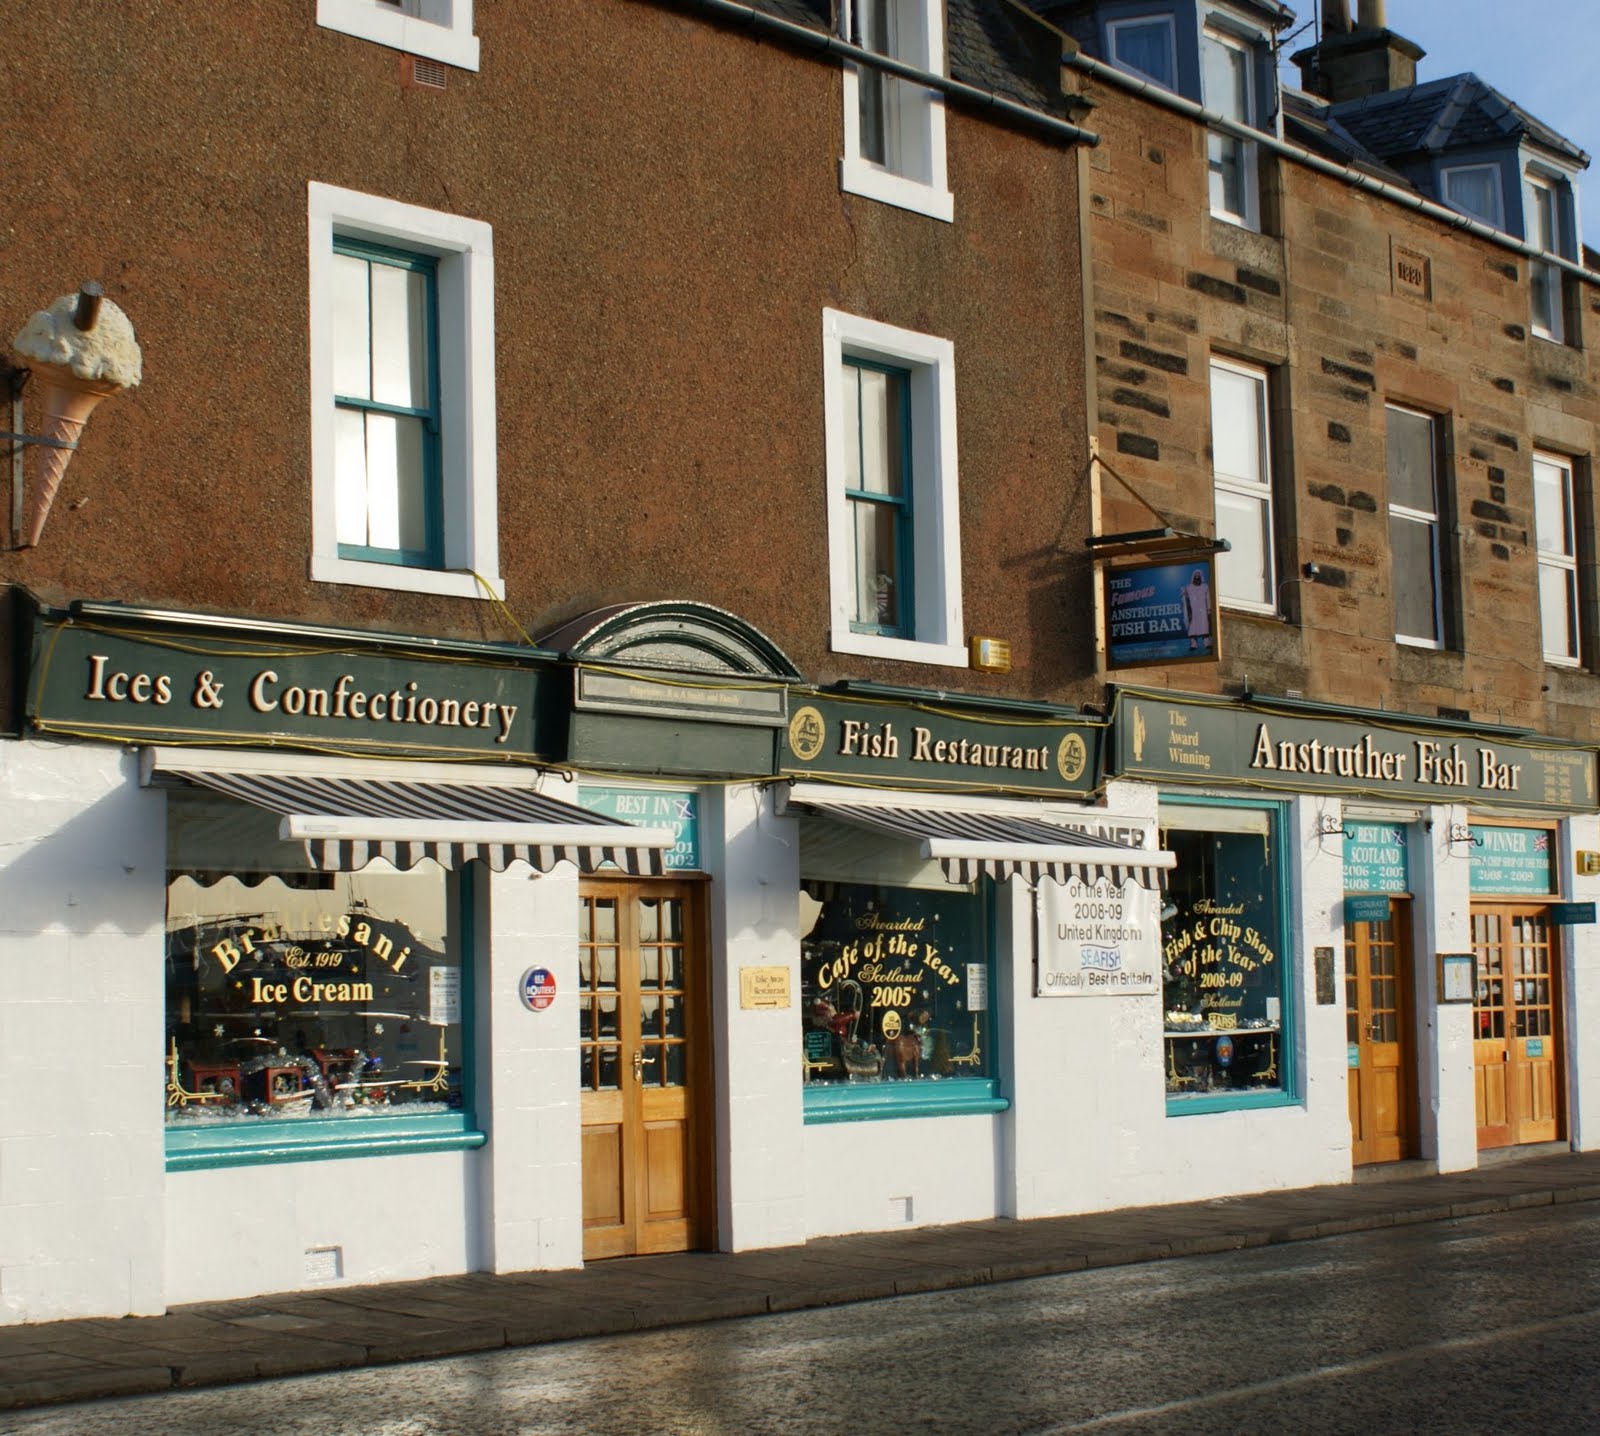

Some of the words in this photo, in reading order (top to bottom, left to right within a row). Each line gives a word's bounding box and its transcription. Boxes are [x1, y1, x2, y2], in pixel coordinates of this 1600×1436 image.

[1110, 578, 1132, 589] THE
[1111, 603, 1182, 621] ANSTRUTHER
[1111, 621, 1146, 637] FISH
[1148, 618, 1182, 633] BAR
[86, 655, 172, 704] Ices
[195, 670, 225, 709] &
[251, 669, 518, 743] Confectionery
[1167, 710, 1187, 726] The
[840, 720, 899, 758] Fish
[912, 727, 1049, 770] Restaurant
[1168, 730, 1199, 746] Award
[1168, 747, 1211, 770] Winning
[1249, 723, 1406, 781] Anstruther
[1415, 740, 1469, 786] Fish
[1479, 748, 1521, 791] Bar
[615, 795, 649, 814] BEST
[653, 797, 671, 815] IN
[1357, 827, 1378, 843] BEST
[1483, 831, 1526, 852] WINNER
[1351, 847, 1400, 864] SCOTLAND
[1379, 867, 1405, 878] 2007
[1510, 871, 1534, 881] 2009
[1070, 883, 1082, 898] of
[1085, 884, 1102, 898] the
[1104, 883, 1126, 899] Year
[1074, 903, 1123, 920] 2008-09
[1193, 899, 1245, 915] Awarded
[856, 913, 925, 931] Awarded
[1057, 924, 1092, 941] United
[1095, 924, 1142, 944] Kingdom
[1165, 929, 1191, 965] Fish
[1194, 921, 1207, 941] &
[1210, 917, 1241, 944] Chip
[1243, 927, 1274, 965] Shop
[818, 939, 859, 989] Café
[864, 934, 884, 962] of
[888, 934, 918, 957] the
[922, 944, 960, 986] Year
[1081, 949, 1121, 968] SEAFISH
[1184, 949, 1198, 978] of
[1201, 944, 1223, 964] the
[1226, 944, 1258, 972] Year
[857, 964, 924, 983] Scotland
[1046, 972, 1085, 989] Officially
[1088, 972, 1108, 986] Best
[1110, 973, 1118, 985] in
[1120, 973, 1152, 986] Britain
[1200, 972, 1243, 988] 2008-09
[251, 977, 288, 1003] Ice
[292, 976, 374, 1003] Cream
[870, 986, 912, 1007] 2005
[1200, 992, 1243, 1008] Scotland
